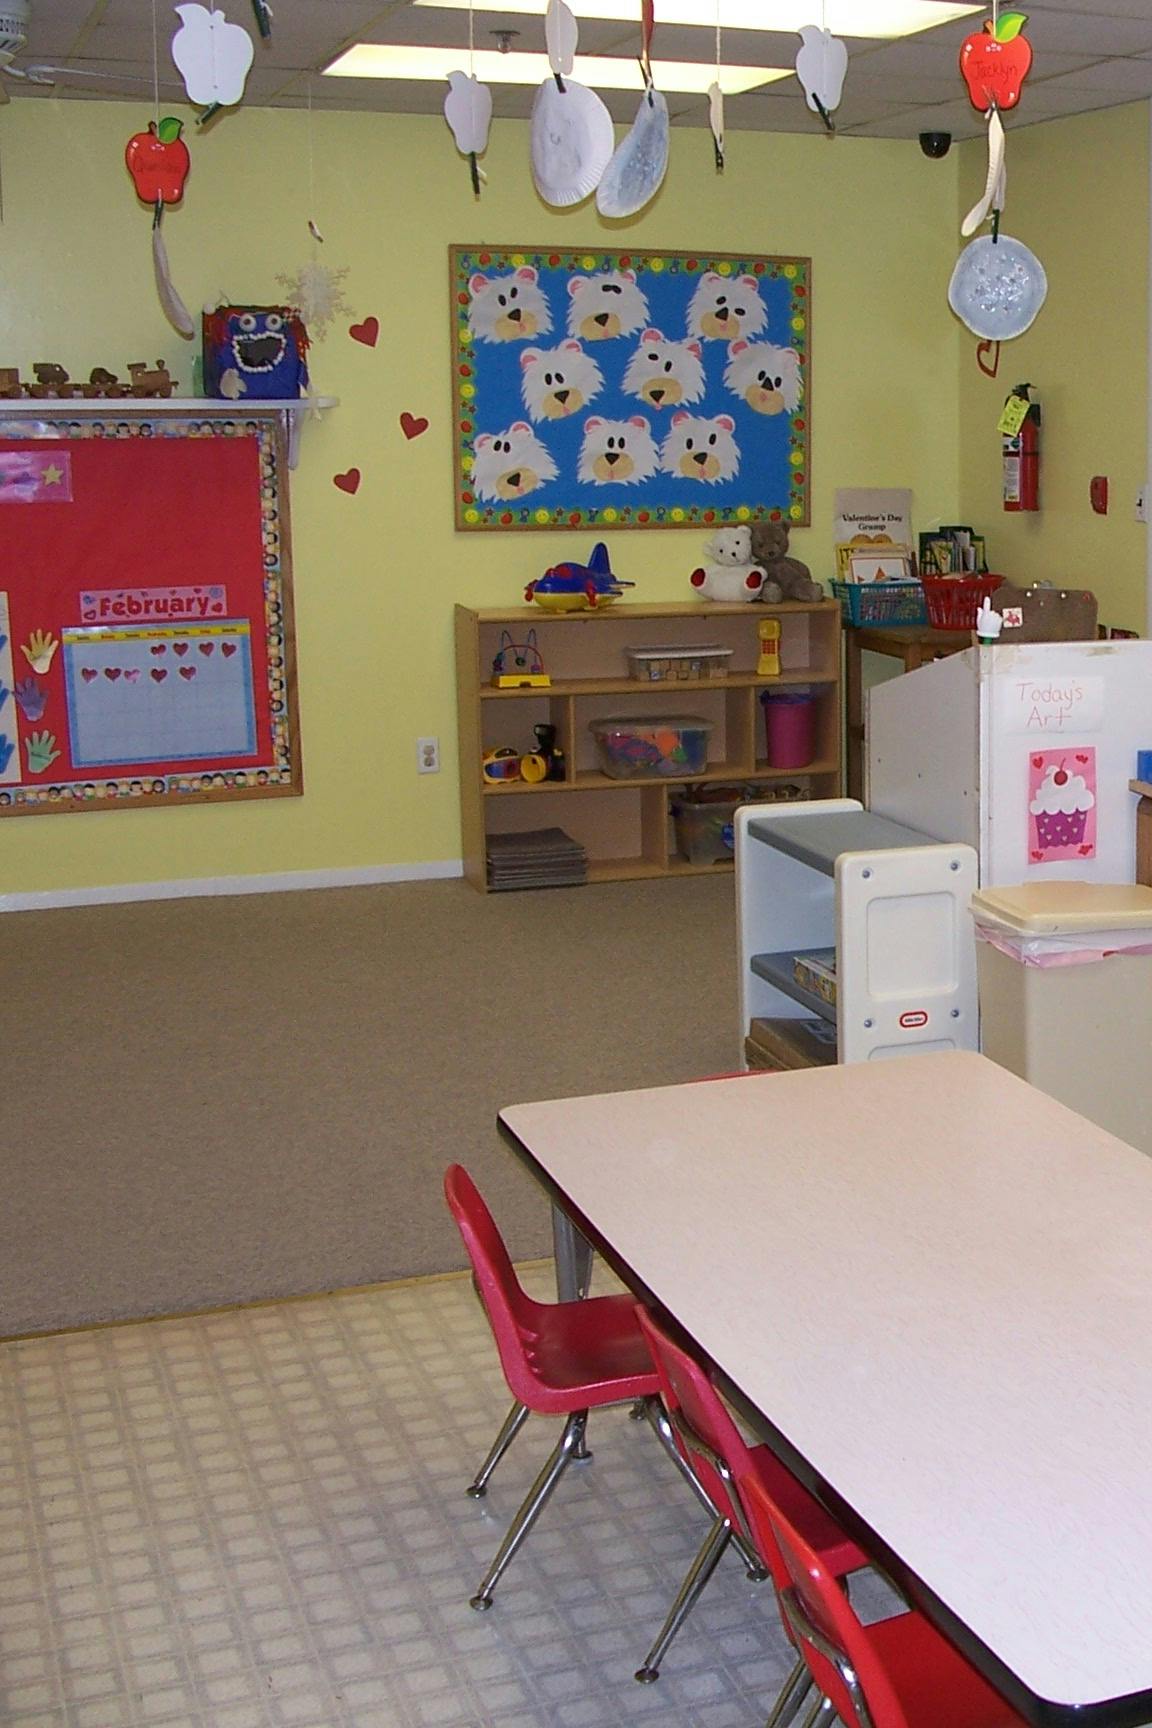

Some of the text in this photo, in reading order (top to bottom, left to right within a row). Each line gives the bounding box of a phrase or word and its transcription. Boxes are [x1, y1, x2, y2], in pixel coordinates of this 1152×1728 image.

[842, 513, 903, 523] Valentine's Day
[858, 523, 887, 531] Grump
[100, 595, 209, 616] February
[1016, 680, 1083, 710] Today's
[1027, 705, 1072, 727] Art
